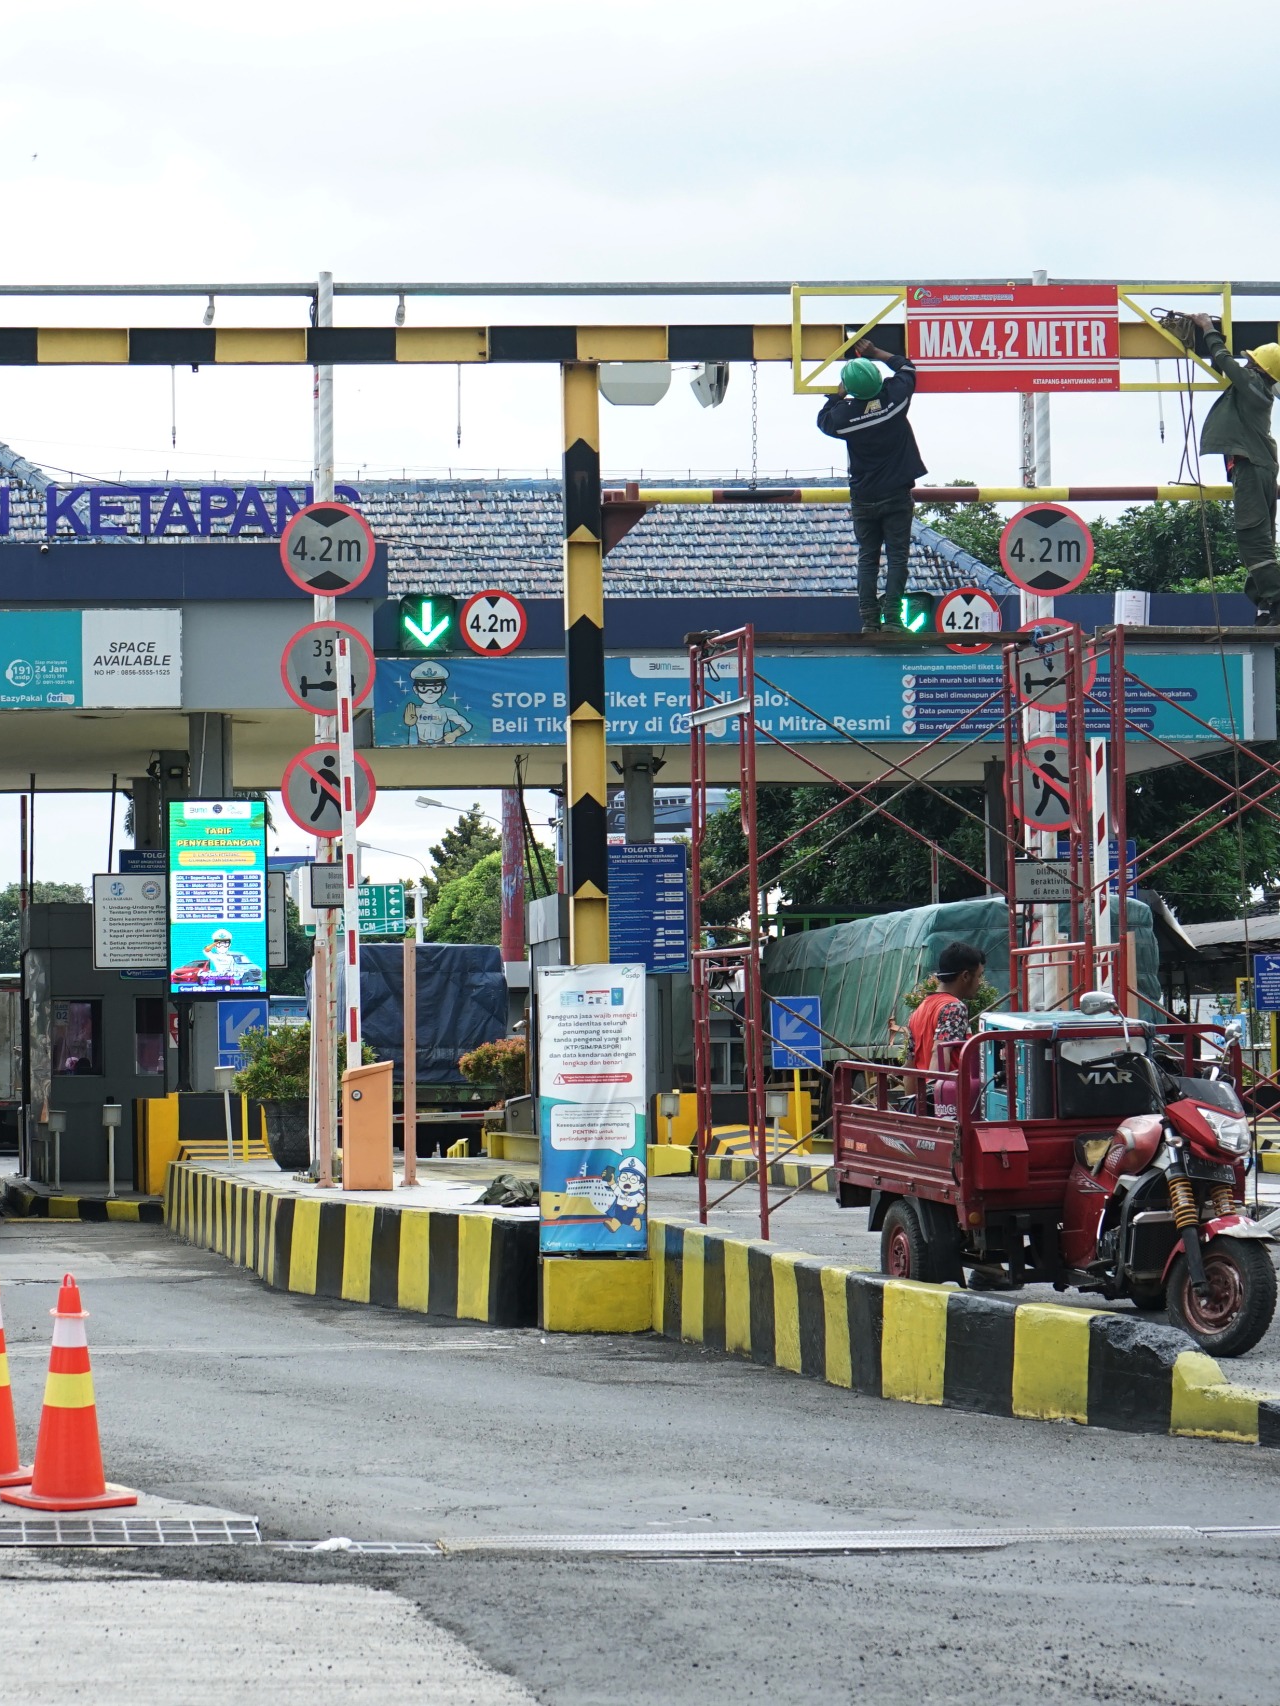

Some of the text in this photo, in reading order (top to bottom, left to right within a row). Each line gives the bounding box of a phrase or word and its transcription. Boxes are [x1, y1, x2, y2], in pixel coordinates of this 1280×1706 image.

[919, 320, 1106, 359] MAX.4,2 METER
[292, 536, 361, 562] 4.2m
[1010, 538, 1082, 564] 4.2m
[470, 614, 517, 633] 4.2m
[109, 642, 156, 653] SPACE
[312, 639, 334, 658] 35
[93, 655, 172, 666] AVAILABLE
[13, 666, 30, 674] 191
[491, 692, 555, 708] STOP
[713, 691, 732, 706] di
[950, 692, 988, 700] dimanapun
[492, 718, 528, 733] Beli
[534, 718, 568, 733] Tike
[645, 716, 663, 732] di
[779, 716, 826, 732] Mitra
[836, 716, 891, 732] Resmi
[204, 827, 234, 835] TARIF
[176, 839, 260, 847] PENYEBERANGAN
[372, 888, 377, 896] 1
[372, 898, 377, 906] 2
[56, 1012, 67, 1020] 02
[227, 1055, 248, 1070] TRU
[1077, 1071, 1133, 1085] VIAR
[916, 1140, 936, 1151] KARYA
